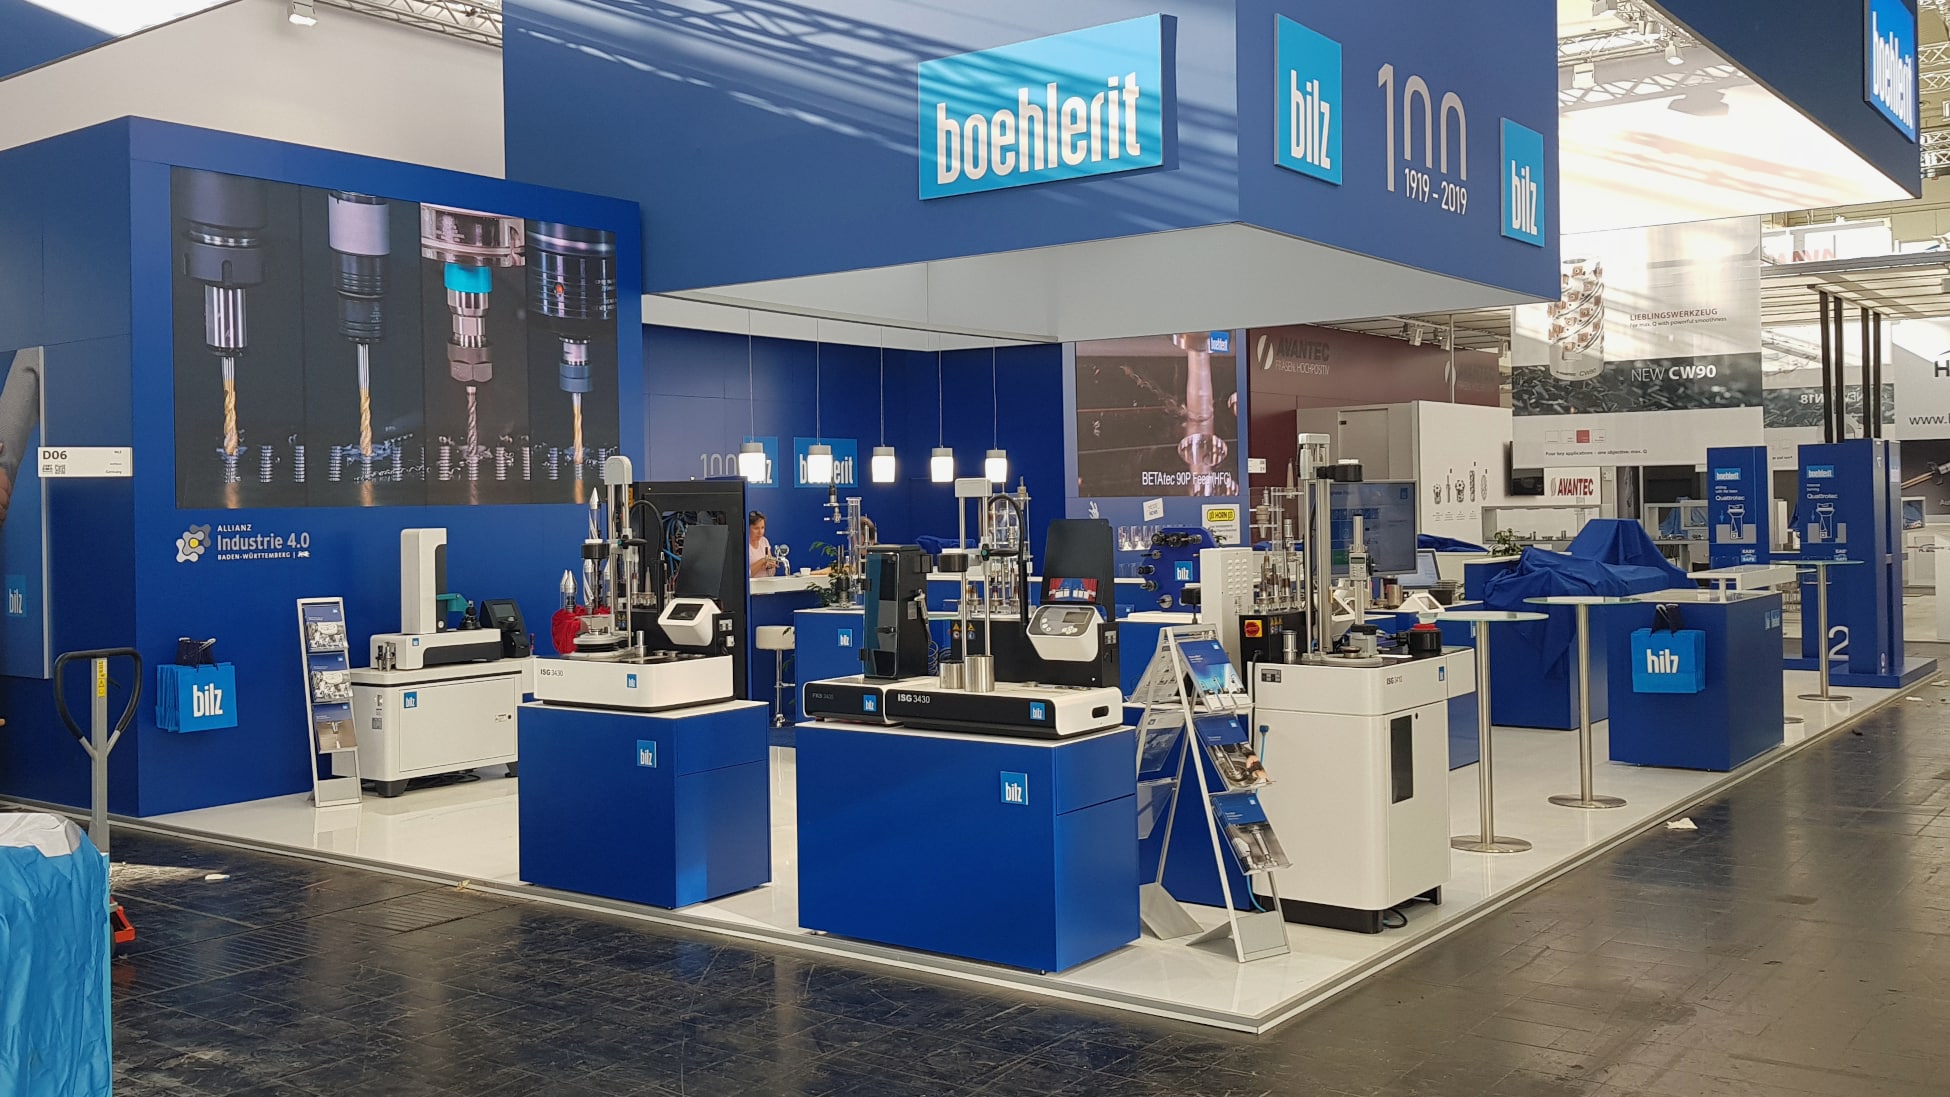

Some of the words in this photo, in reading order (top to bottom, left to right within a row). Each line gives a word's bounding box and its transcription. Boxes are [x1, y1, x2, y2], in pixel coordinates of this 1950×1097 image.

[1872, 11, 1913, 130] boehlerit
[936, 71, 1142, 185] boehlerit
[1290, 68, 1331, 170] bilz
[1404, 167, 1430, 203] 1919
[1441, 177, 1467, 215] 2019
[1511, 159, 1538, 235] bilz
[1630, 308, 1718, 321] LIEBLINGSWERKZEUG
[1670, 318, 1694, 326] powerful
[1276, 338, 1330, 362] AVANTEC
[1631, 368, 1665, 382] NEW
[1668, 365, 1717, 380] CW90
[42, 450, 68, 460] D06
[800, 453, 854, 484] berit
[1142, 471, 1176, 486] BETAtec
[1176, 471, 1191, 486] 90P
[1557, 478, 1594, 496] AVANTEC
[217, 524, 252, 532] ALLIANZ
[217, 533, 284, 551] Industrie
[287, 532, 310, 549] 4.0
[217, 551, 291, 561] BADEN-WÜRTTEMBERG
[1176, 567, 1190, 581] bilz
[9, 588, 23, 614] bilz
[540, 668, 551, 676] ISG
[192, 683, 224, 717] bilz
[897, 693, 913, 702] ISG
[913, 696, 931, 704] 3430
[1032, 706, 1043, 720] bilz
[640, 748, 653, 766] bilz
[1005, 782, 1022, 802] bilz
